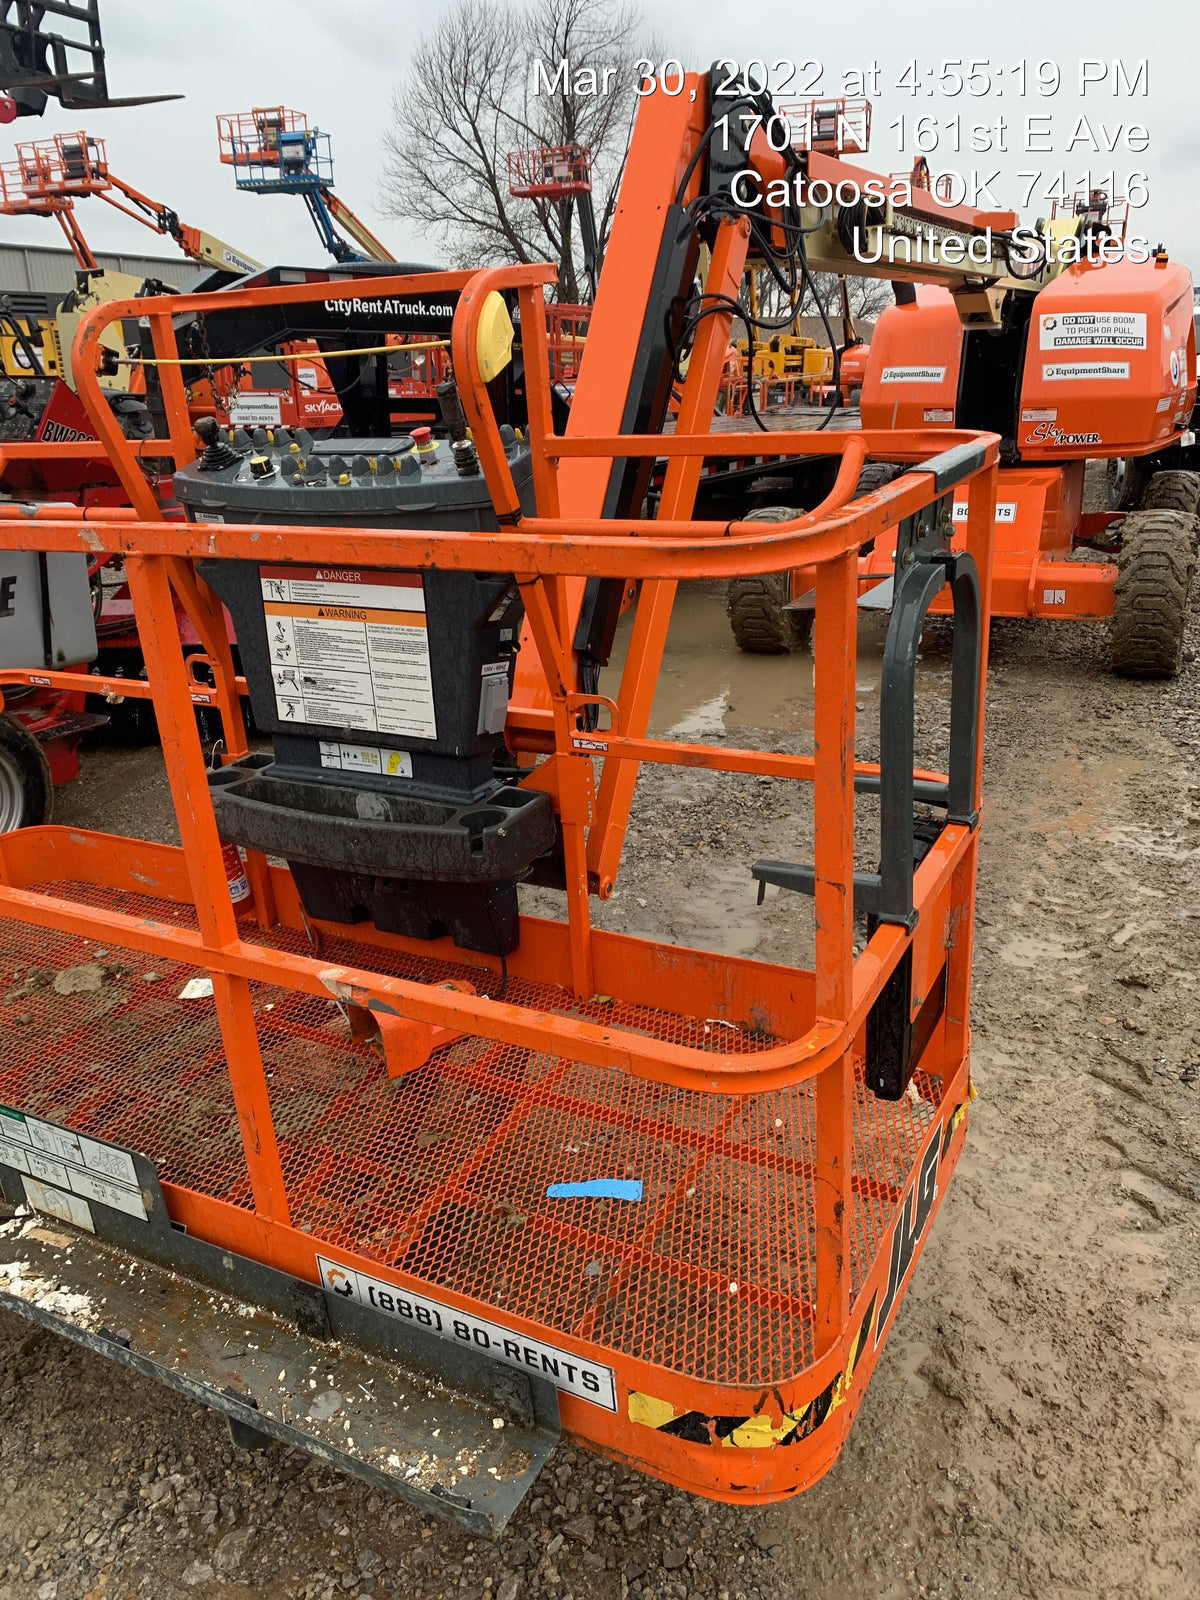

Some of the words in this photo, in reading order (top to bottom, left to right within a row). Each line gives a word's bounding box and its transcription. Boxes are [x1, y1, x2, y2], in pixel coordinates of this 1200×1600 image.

[324, 298, 454, 316] CityRentATruck.com
[1063, 316, 1076, 324] DO
[1078, 316, 1095, 324] NOT
[1096, 316, 1111, 324] USE
[1113, 316, 1135, 324] BOOM
[1055, 337, 1092, 345] DAMAGE
[1115, 337, 1143, 345] OCCUR
[889, 370, 941, 379] EquipmentShare
[1055, 366, 1126, 376] EquipmentShare
[323, 570, 361, 582] DANGER
[325, 608, 367, 620] WARNING
[367, 1285, 443, 1332] (888)
[453, 1318, 600, 1394] 80-RENTS
